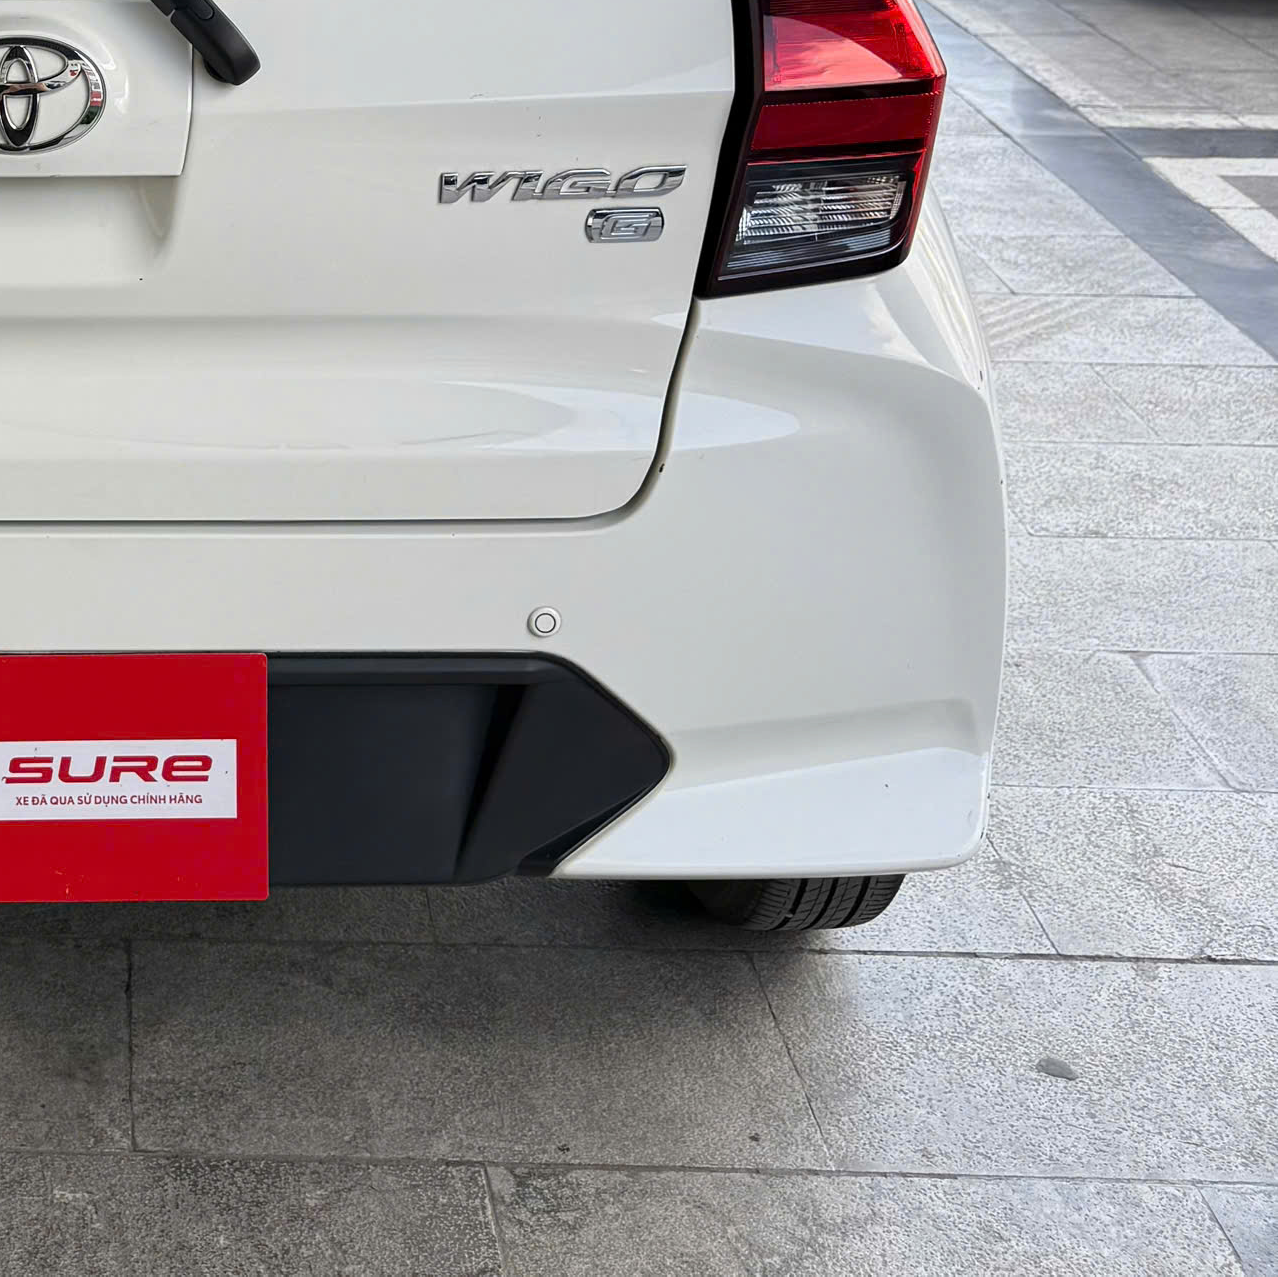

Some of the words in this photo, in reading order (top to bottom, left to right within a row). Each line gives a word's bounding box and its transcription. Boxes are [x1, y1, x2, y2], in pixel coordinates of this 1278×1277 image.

[438, 164, 688, 204] WIGO
[15, 796, 29, 806] XE
[31, 793, 48, 806] ĐÃ
[50, 796, 75, 806] QUA
[77, 792, 93, 805] SỬ
[94, 795, 128, 808] DỤNG
[130, 792, 167, 805] CHÍNH
[168, 792, 203, 805] HÃNG
